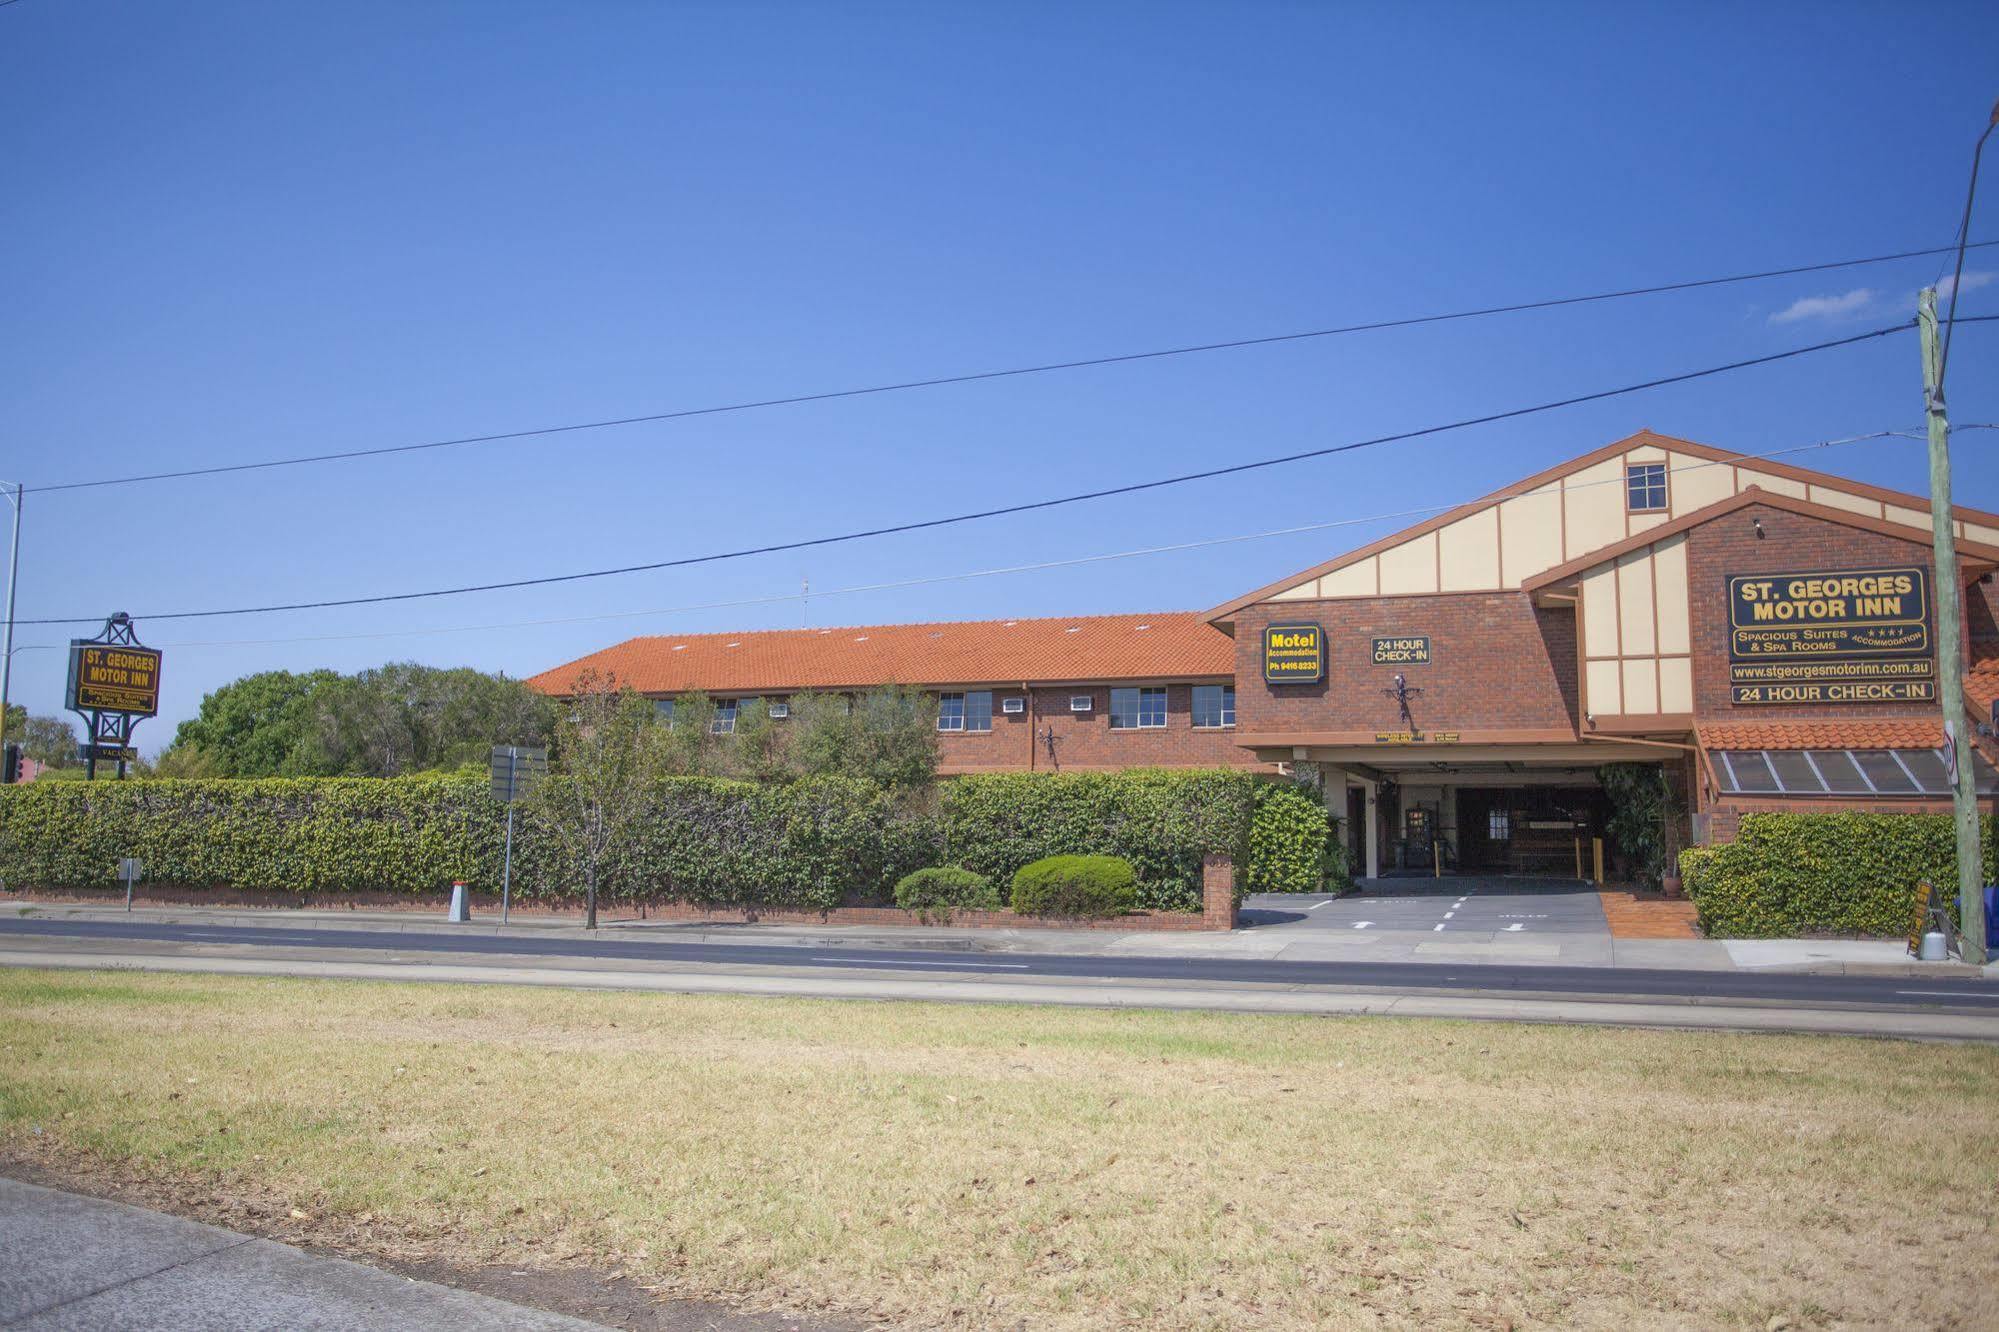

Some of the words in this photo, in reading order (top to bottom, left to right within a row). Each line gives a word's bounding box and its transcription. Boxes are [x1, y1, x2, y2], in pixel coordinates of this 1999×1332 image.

[1741, 582, 1779, 601] ST.
[1788, 575, 1912, 599] GEORGES
[1754, 600, 1846, 621] MOTOR
[1856, 597, 1901, 617] INN
[1271, 633, 1315, 648] Motel
[1738, 631, 1797, 642] SPACIOUS
[1803, 629, 1848, 640] SUITES
[1852, 631, 1922, 647] ACCOMMODATION
[1268, 648, 1317, 657] Accommodation
[1377, 640, 1391, 651] 24
[1393, 639, 1424, 650] HOUR
[1751, 643, 1760, 651] &
[1764, 642, 1786, 651] SPA
[1792, 641, 1836, 651] ROOMS
[87, 649, 103, 665] ST.
[107, 652, 154, 671] GEORGES
[1375, 650, 1427, 662] CHECK-IN
[1269, 661, 1280, 670] Ph
[1734, 662, 1928, 679] www.stgeorgesmotorinn.com.au
[90, 667, 127, 684] MOTOR
[131, 672, 149, 687] INN
[1740, 688, 1760, 701] 24
[1768, 686, 1821, 701] HOUR
[1828, 684, 1926, 700] CHECK-IN
